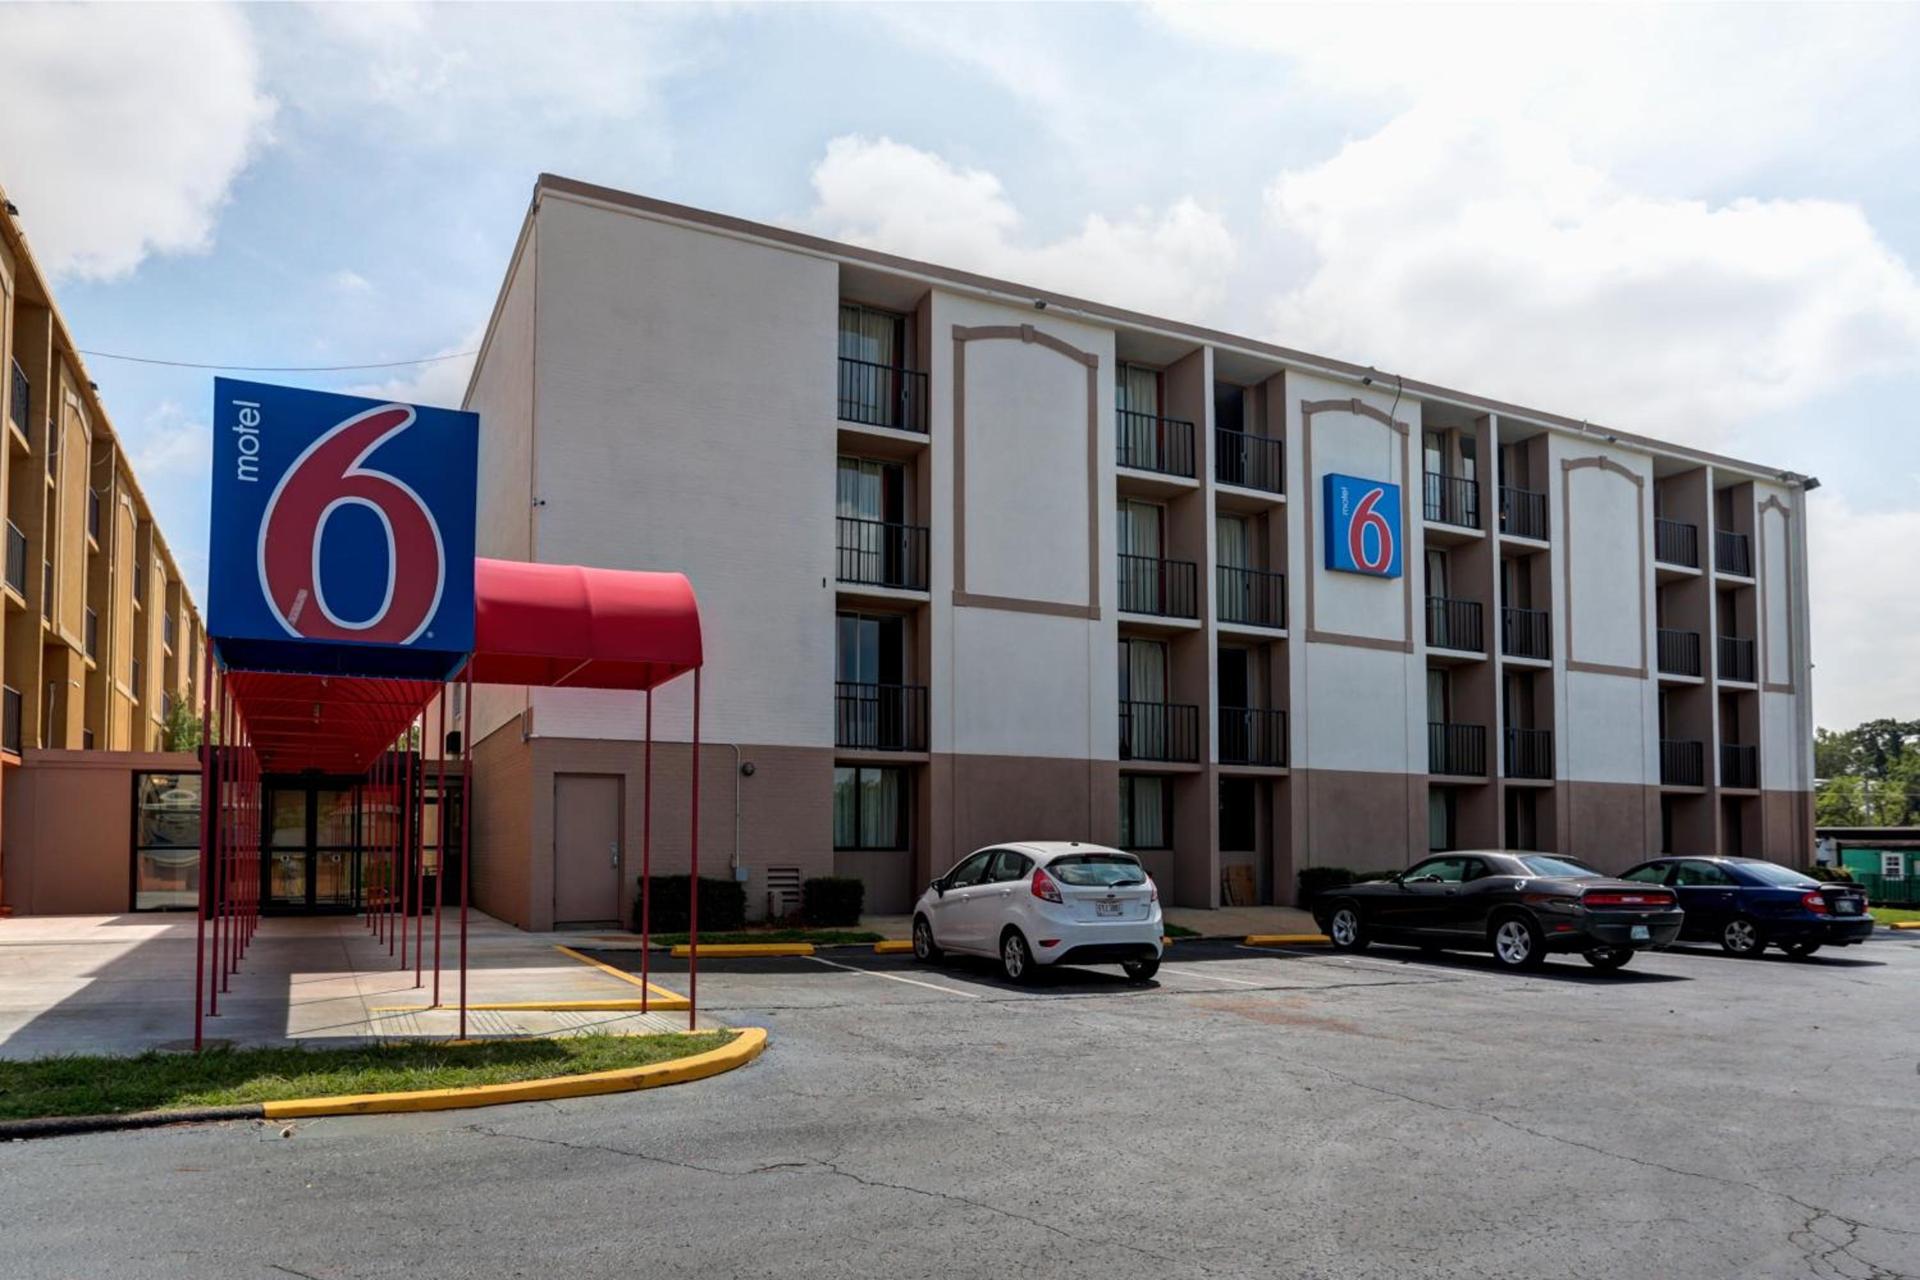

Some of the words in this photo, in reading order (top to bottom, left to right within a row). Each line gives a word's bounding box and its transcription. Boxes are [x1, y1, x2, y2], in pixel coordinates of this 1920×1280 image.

[232, 399, 261, 482] motel
[257, 402, 446, 645] 6
[1341, 486, 1349, 516] motel
[1348, 487, 1394, 573] 6
